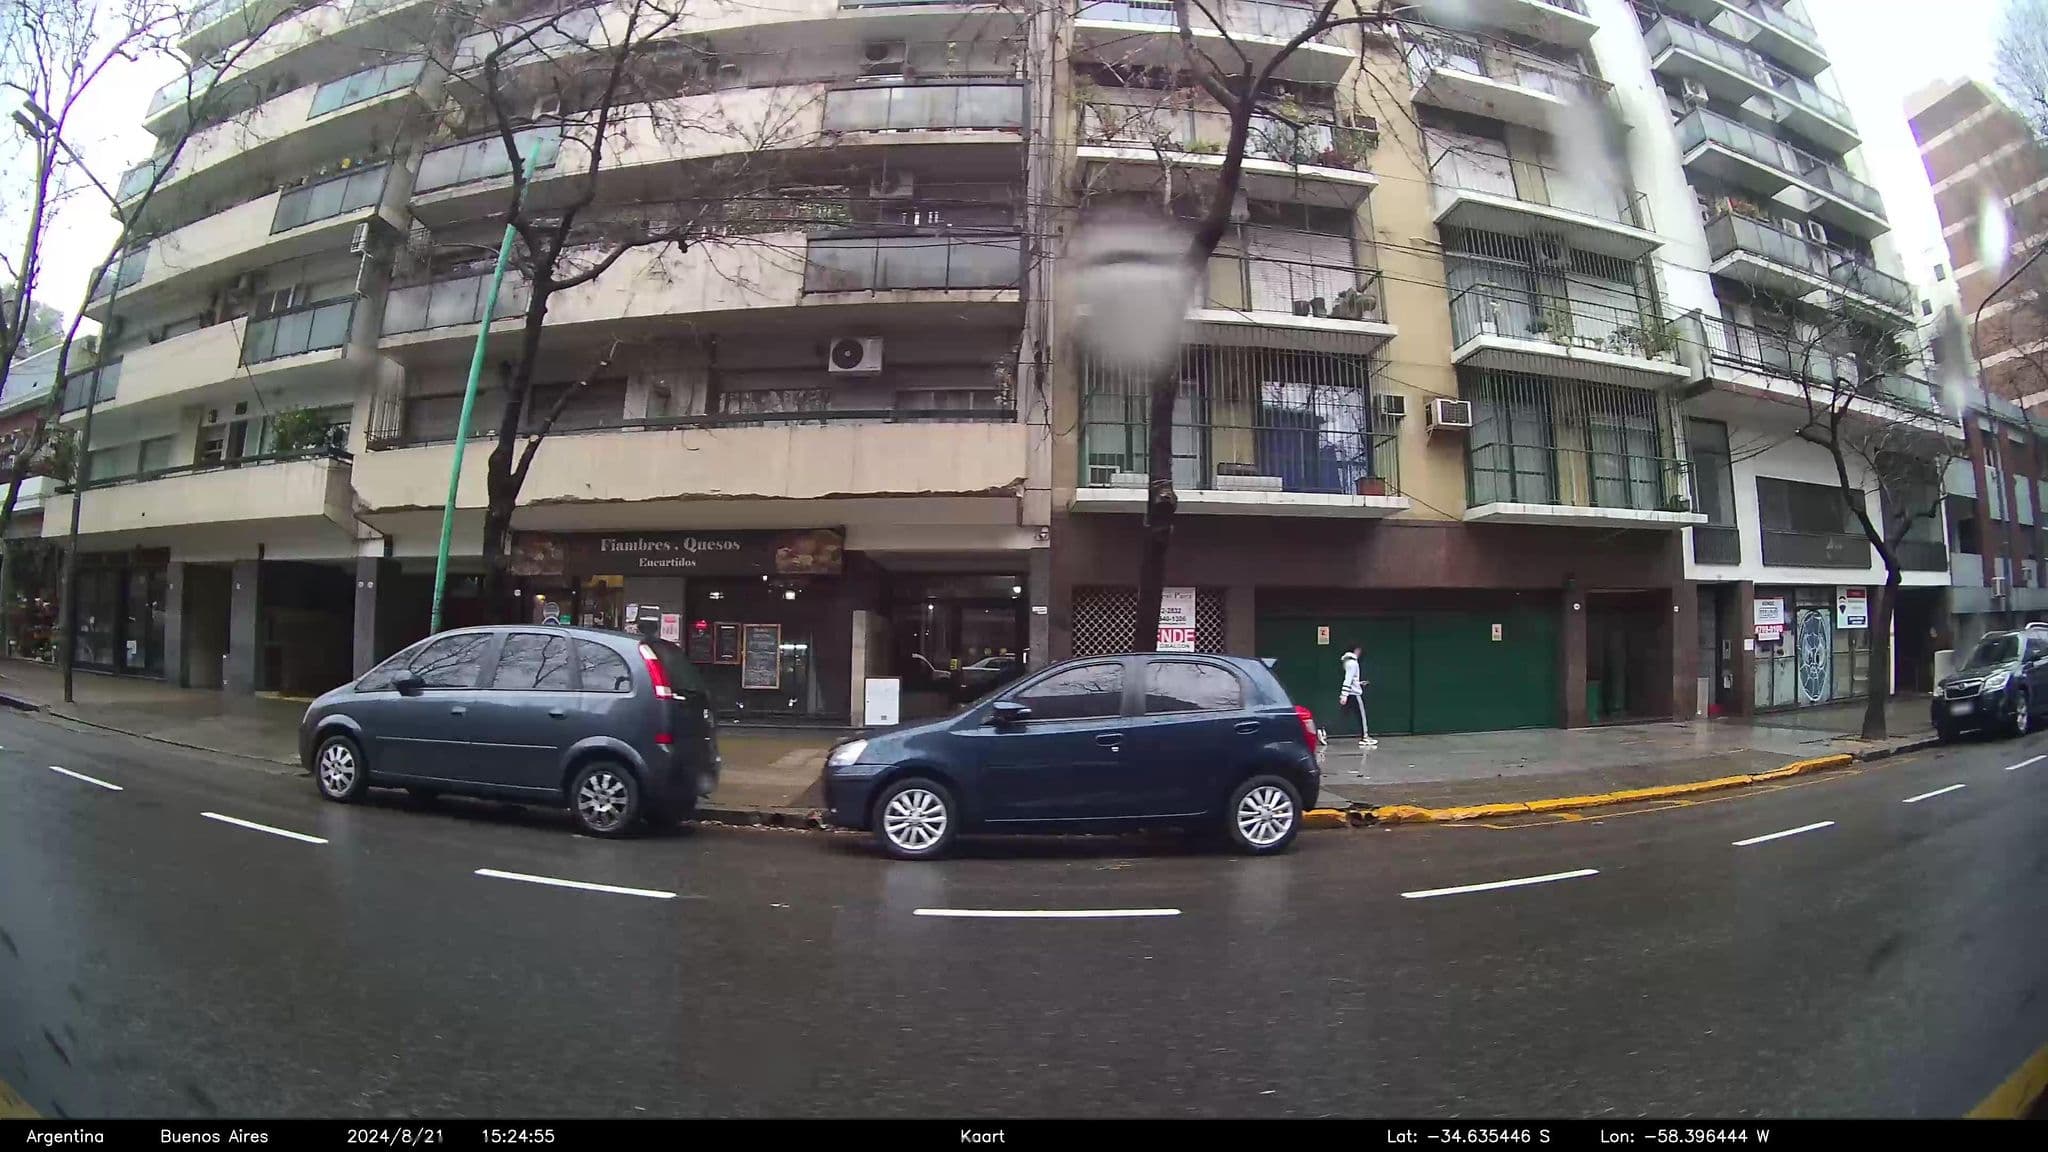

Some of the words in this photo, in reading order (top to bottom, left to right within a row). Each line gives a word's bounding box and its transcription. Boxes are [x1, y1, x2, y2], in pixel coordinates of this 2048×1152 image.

[600, 537, 671, 551] Fiambres
[683, 537, 741, 553] Quesos
[639, 557, 696, 567] Encurtidos
